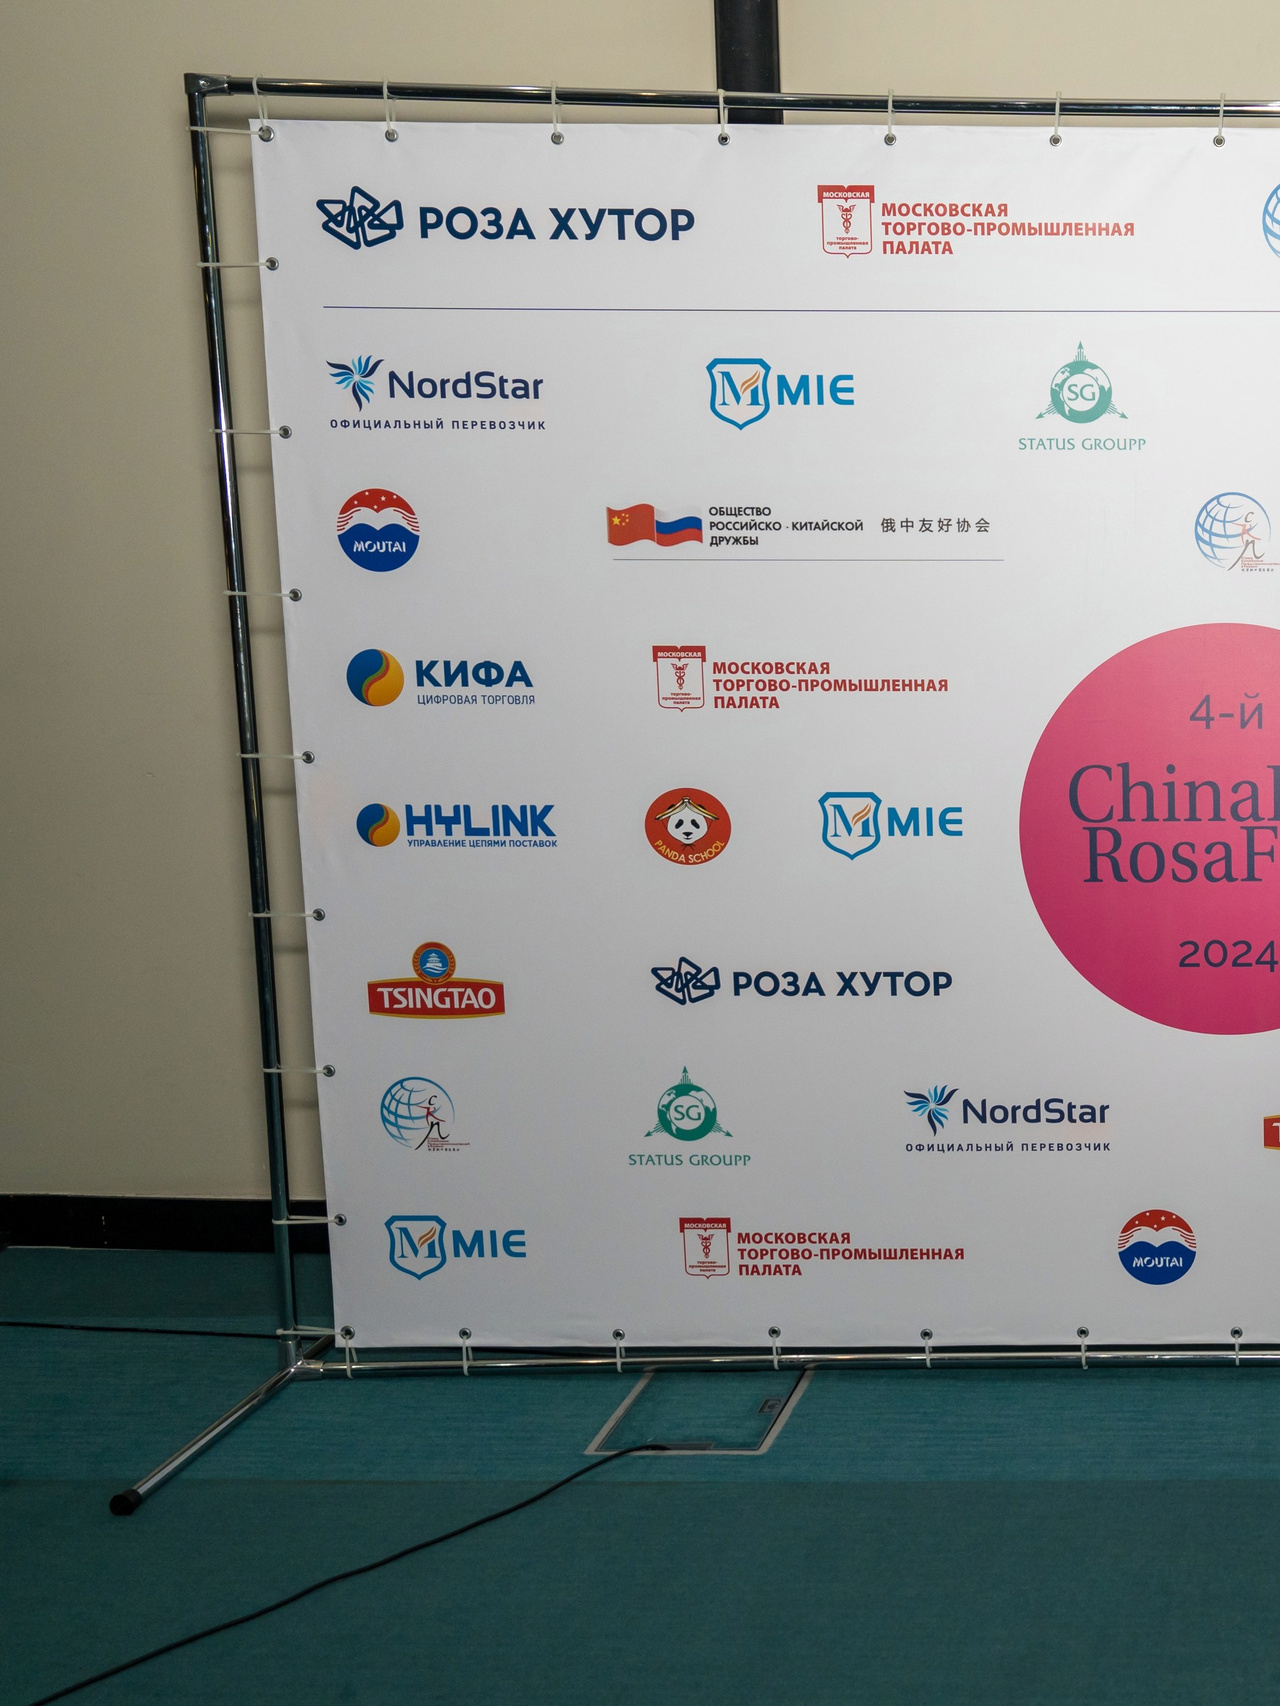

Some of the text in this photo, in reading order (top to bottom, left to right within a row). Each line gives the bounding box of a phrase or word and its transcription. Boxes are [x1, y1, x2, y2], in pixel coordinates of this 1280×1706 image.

[882, 203, 1007, 217] МОСКОВСКАЯ
[420, 206, 694, 241] РОЗА ХУТОР
[882, 222, 1134, 236] ТОРГОВО-ПРОМЫШЛЕННАЯ
[883, 241, 953, 254] ПАЛАТА
[389, 371, 543, 399] NordStar
[777, 375, 854, 405] MIE
[1066, 382, 1096, 402] SG
[330, 418, 545, 430] ОФИЦИАЛЬНЫЙ ПЕРЕВОЗЧИК
[1019, 438, 1146, 450] STATUS GROUPP
[709, 507, 771, 517] ОБЩЕСТВО
[710, 519, 781, 530] РОССИЙСКО
[792, 520, 863, 531] КИТАЙСКОЙ
[881, 518, 990, 532] 俄中友好协会
[354, 541, 405, 552] MOUTAI
[710, 536, 758, 547] ДРУЖБЫ
[416, 660, 533, 687] КИФА
[713, 662, 829, 674] МОСКОВСКАЯ
[713, 679, 947, 691] ТОРГОВО-ПРОМЫШЛЕННАЯ
[418, 695, 535, 705] ЦИФРОВАЯ ТОРГОВЛЯ
[714, 696, 779, 708] ПАЛАТА
[1190, 693, 1262, 729] 4-й
[405, 804, 556, 836] HYLINK
[888, 807, 962, 836] MIE
[469, 840, 506, 848] ЦЕПЯМИ
[654, 840, 725, 863] PANDA SCHOOL
[1179, 940, 1278, 972] 2024
[733, 971, 952, 997] РОЗА ХУТОР
[376, 987, 496, 1010] TSINGTAO
[674, 1102, 702, 1122] SG
[963, 1098, 1109, 1123] NordStar
[906, 1141, 1110, 1153] ОФИЦИАЛЬНЫЙ ПЕРЕВОЗЧИК
[629, 1154, 751, 1166] STATUS GROUPP
[452, 1230, 526, 1257] MIE
[738, 1233, 850, 1244] МОСКОВСКАЯ
[738, 1248, 964, 1260] ТОРГОВО-ПРОМЫШЛЕННАЯ
[1133, 1257, 1182, 1267] MOUTAI
[739, 1264, 802, 1275] ПАЛАТА
